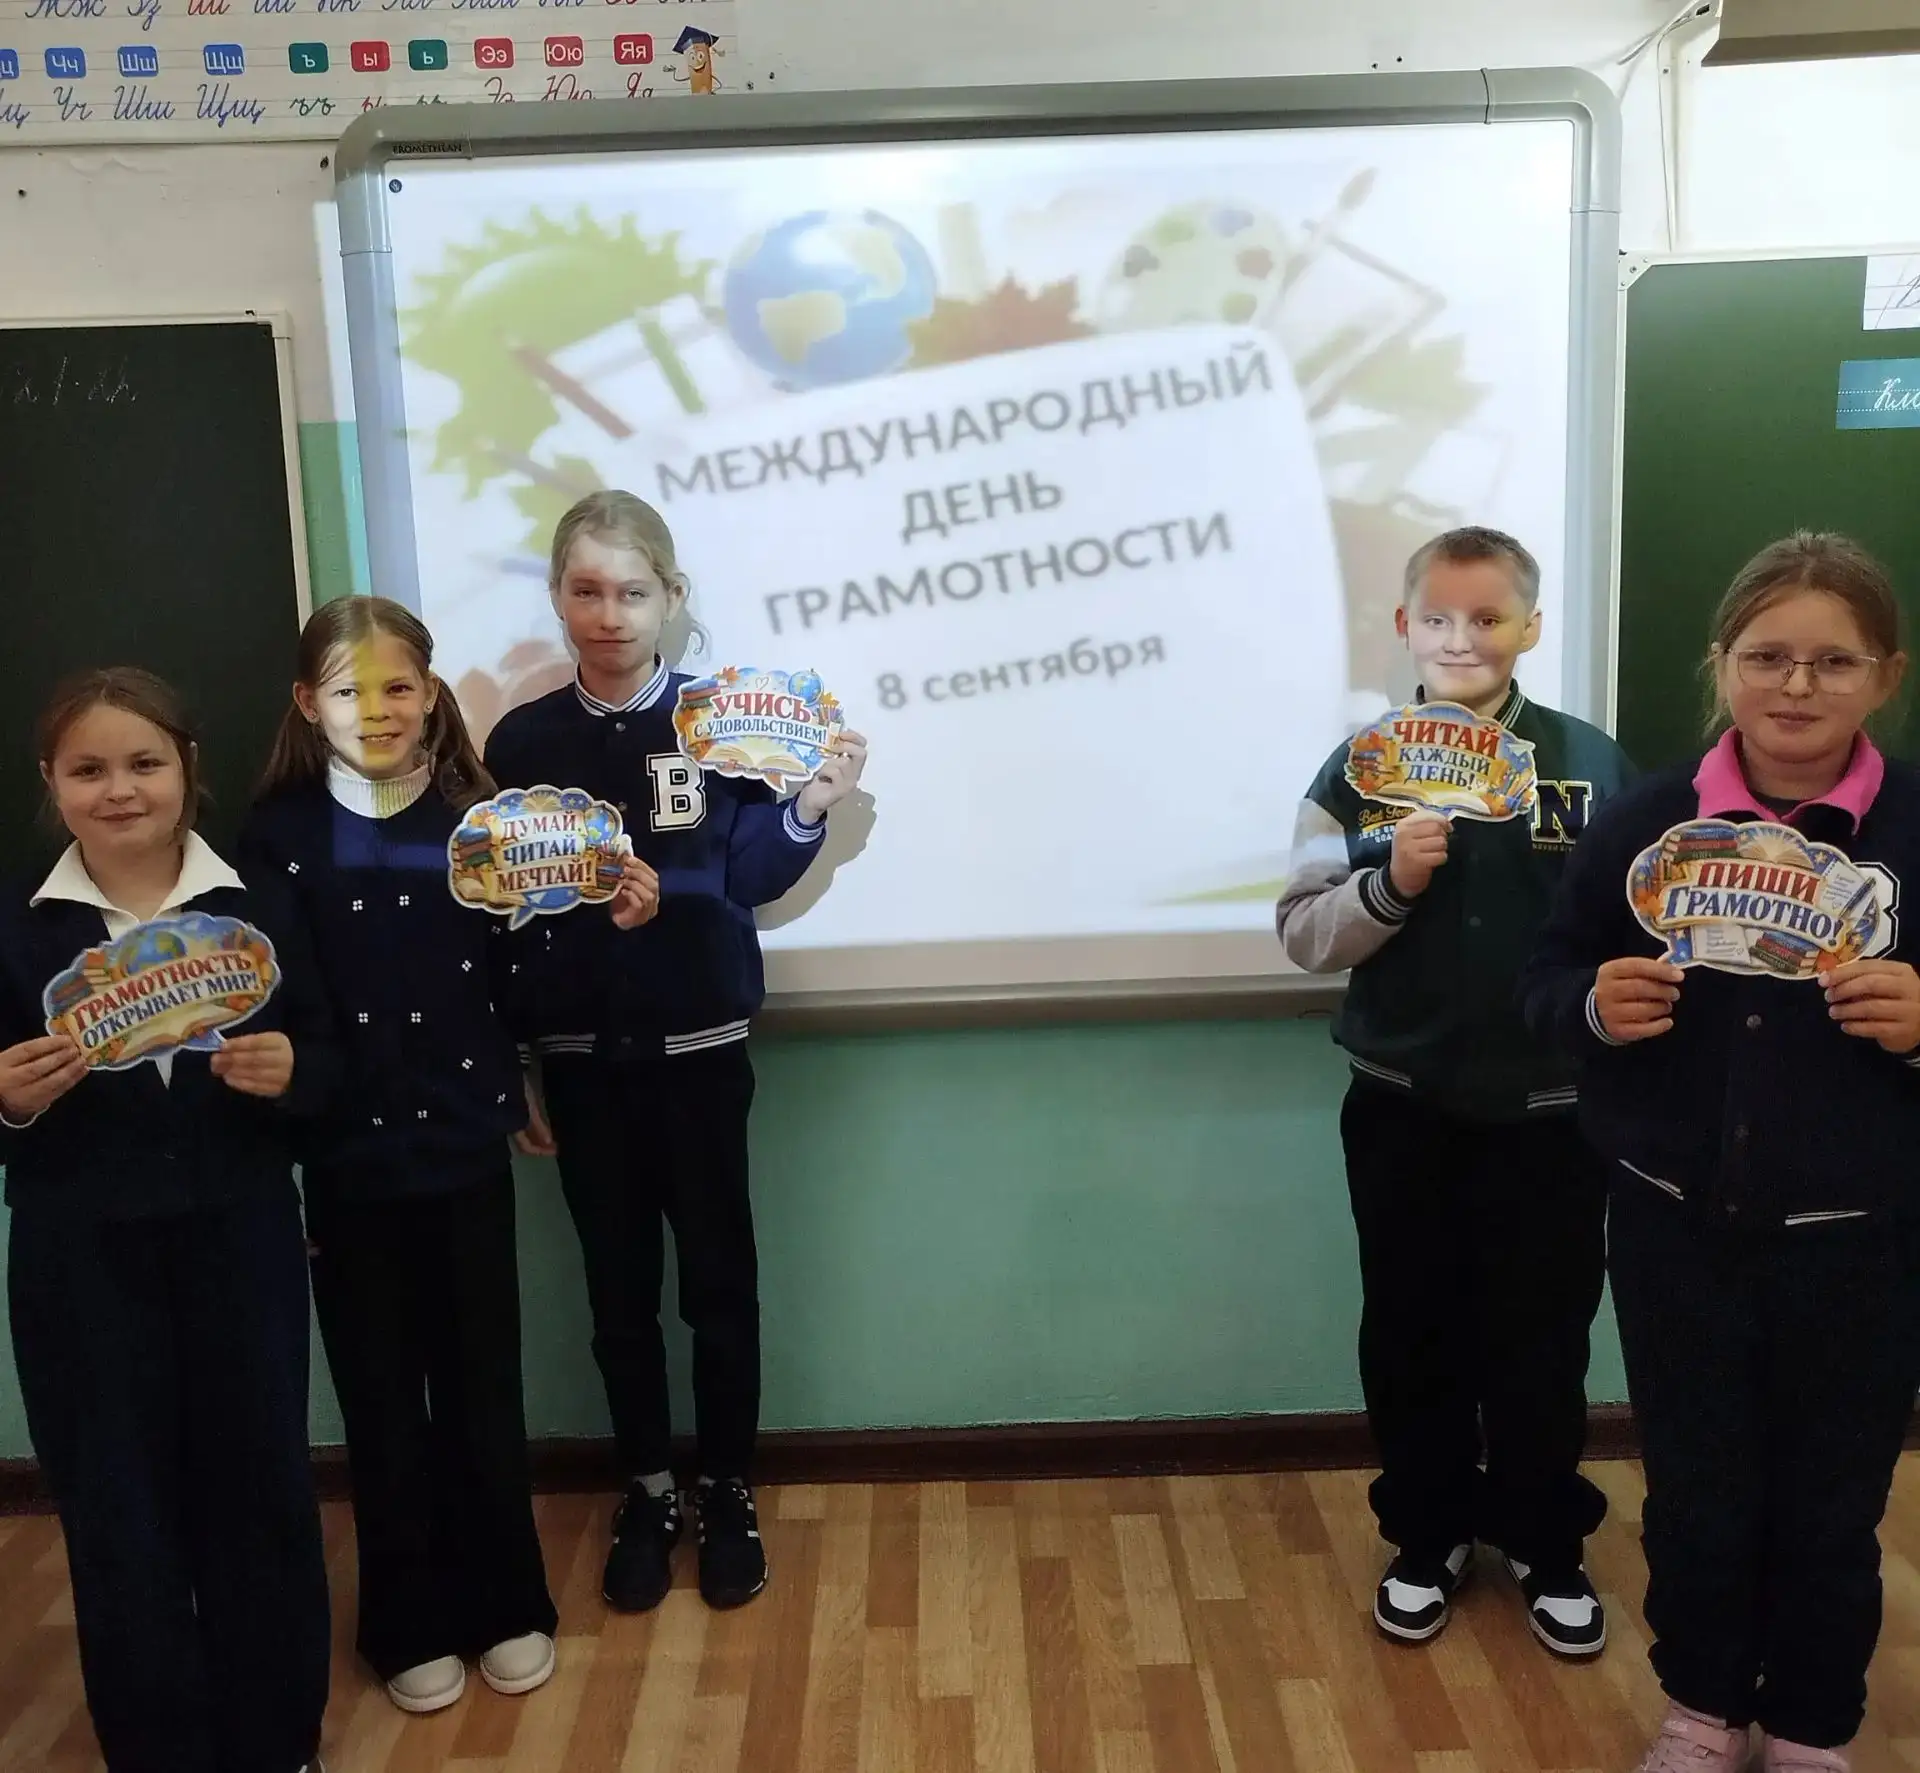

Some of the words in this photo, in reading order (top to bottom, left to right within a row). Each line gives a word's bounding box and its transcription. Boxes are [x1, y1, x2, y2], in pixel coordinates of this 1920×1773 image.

[0, 60, 14, 77] ц
[52, 55, 78, 72] Чч
[119, 54, 157, 72] Шш
[205, 52, 244, 74] Щщ
[481, 45, 507, 63] Ээ
[546, 43, 583, 62] Юю
[620, 42, 647, 60] Яя
[53, 85, 93, 121] Чч
[114, 85, 175, 120] Шш
[197, 83, 266, 128] Щщ
[656, 341, 1275, 500] МЕЖДУНАРОДНЫЙ
[900, 470, 1064, 544] ДЕНЬ
[764, 512, 1234, 635] ГРАМОТНОСТИ
[876, 672, 909, 711] 8
[923, 633, 1166, 701] сентября
[707, 718, 828, 744] УДОВОЛЬСТВИЕМ!
[711, 692, 812, 723] УЧИСЬ
[1393, 720, 1500, 760] ЧИТАЙ
[1400, 748, 1491, 776] КАЖДЫЙ
[647, 753, 706, 832] B
[1407, 764, 1475, 791] ДЕНЬ!
[1531, 780, 1592, 844] N
[497, 858, 593, 892] МЕЧТАЙ!
[1697, 862, 1821, 905] ПИШИ
[1663, 886, 1844, 948] ГРАМОТНО!
[73, 952, 251, 1033] ГРАМОТНОСТЬ
[84, 980, 204, 1048] ОТКРЫВАЕТ
[206, 971, 260, 996] МИР!
